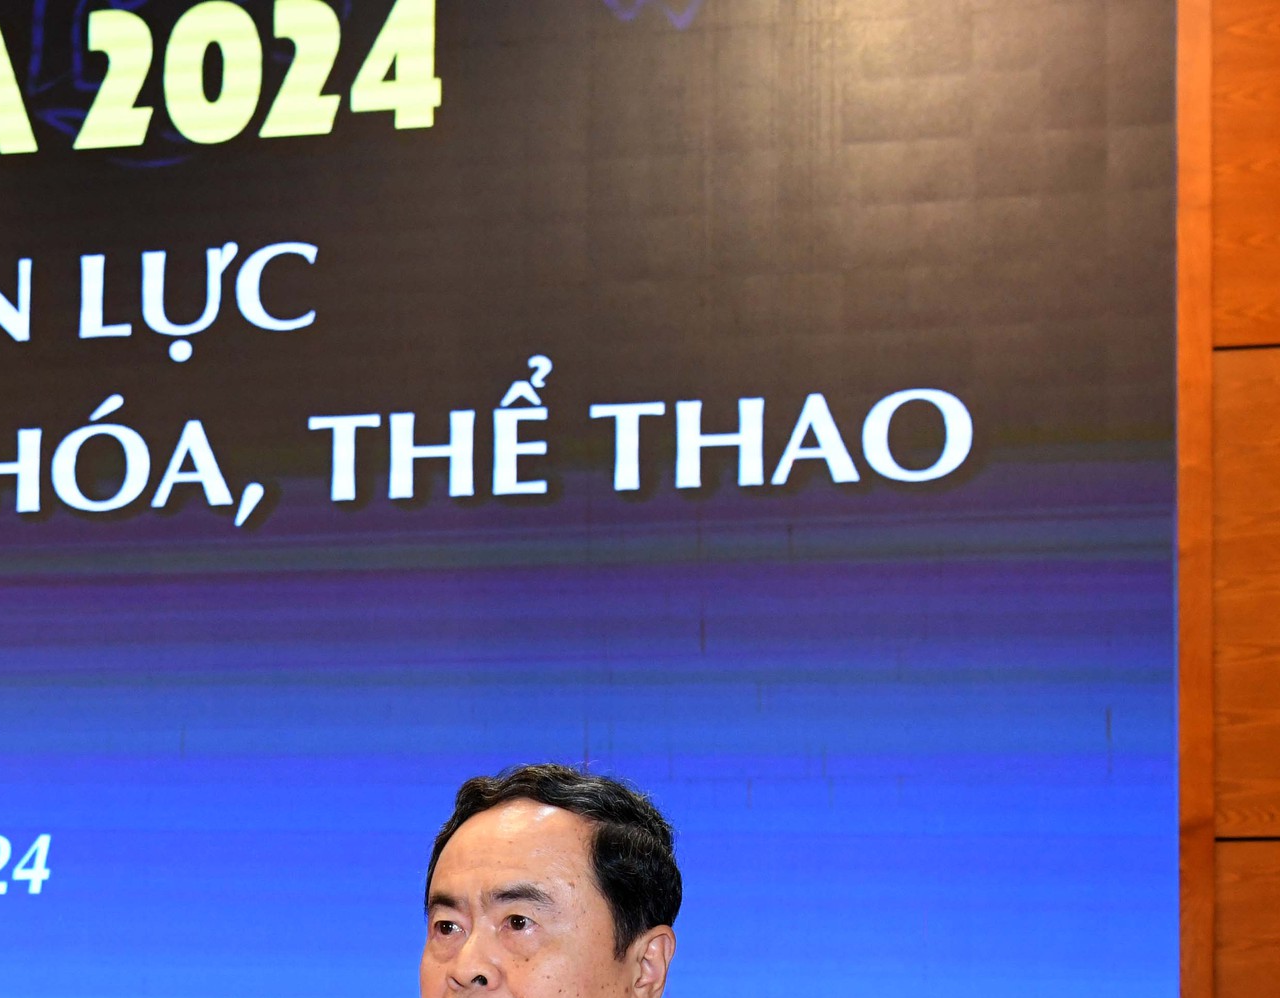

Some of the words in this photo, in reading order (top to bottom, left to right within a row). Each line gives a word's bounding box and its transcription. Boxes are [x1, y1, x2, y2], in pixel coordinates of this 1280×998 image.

[73, 0, 442, 151] 2024
[79, 242, 318, 362] LỰC
[308, 354, 553, 501] THỂ
[590, 388, 974, 491] THAO
